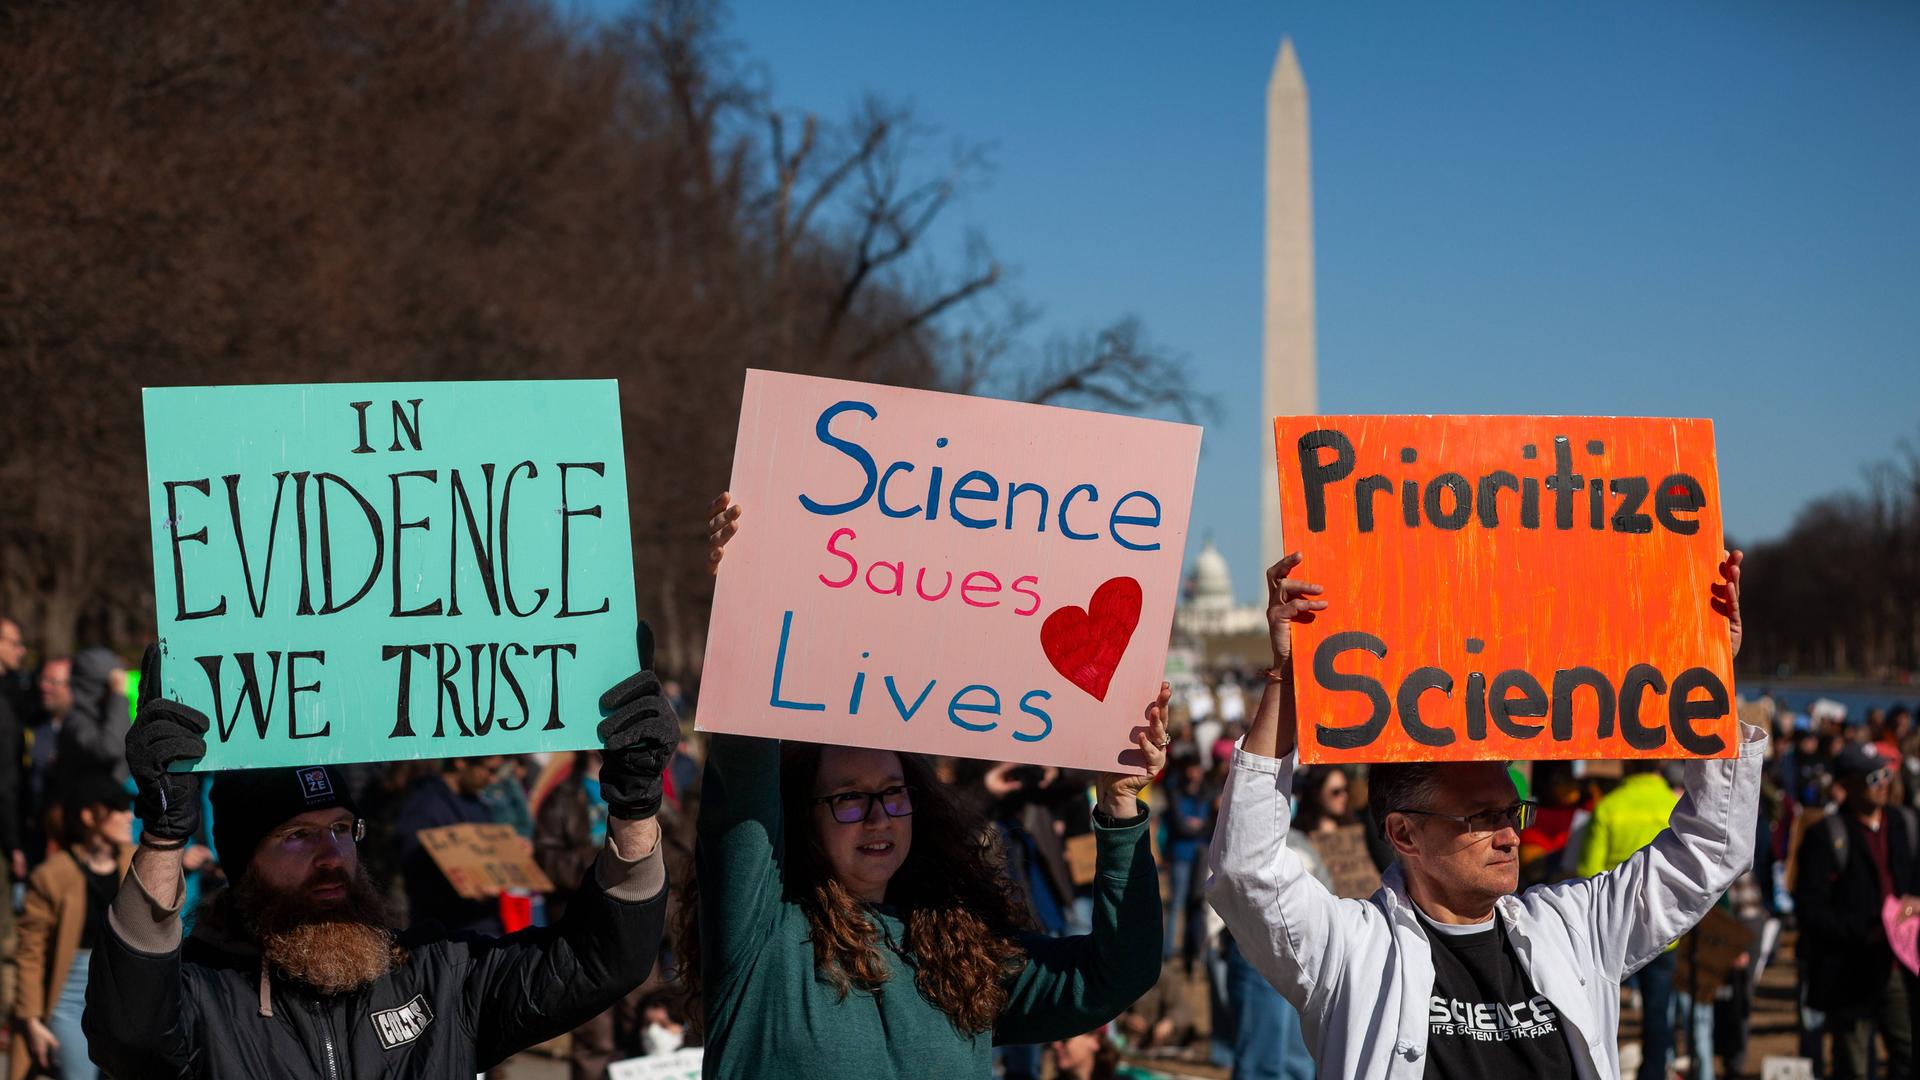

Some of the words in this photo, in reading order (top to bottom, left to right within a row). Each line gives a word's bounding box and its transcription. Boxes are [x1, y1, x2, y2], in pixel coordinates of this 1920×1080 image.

[350, 399, 423, 453] IN
[799, 400, 1162, 551] Science
[1298, 429, 1707, 535] Prioritize
[163, 461, 610, 621] EVIDENCE
[194, 650, 330, 743] WE
[382, 643, 576, 739] TRUST
[770, 610, 1052, 743] Lives
[1312, 631, 1730, 756] Science
[378, 1001, 427, 1044] COLTS
[1429, 995, 1557, 1029] SCIENCE
[1432, 1024, 1454, 1036] IT'S
[1495, 1031, 1510, 1042] US
[1530, 1023, 1557, 1039] FAR.
